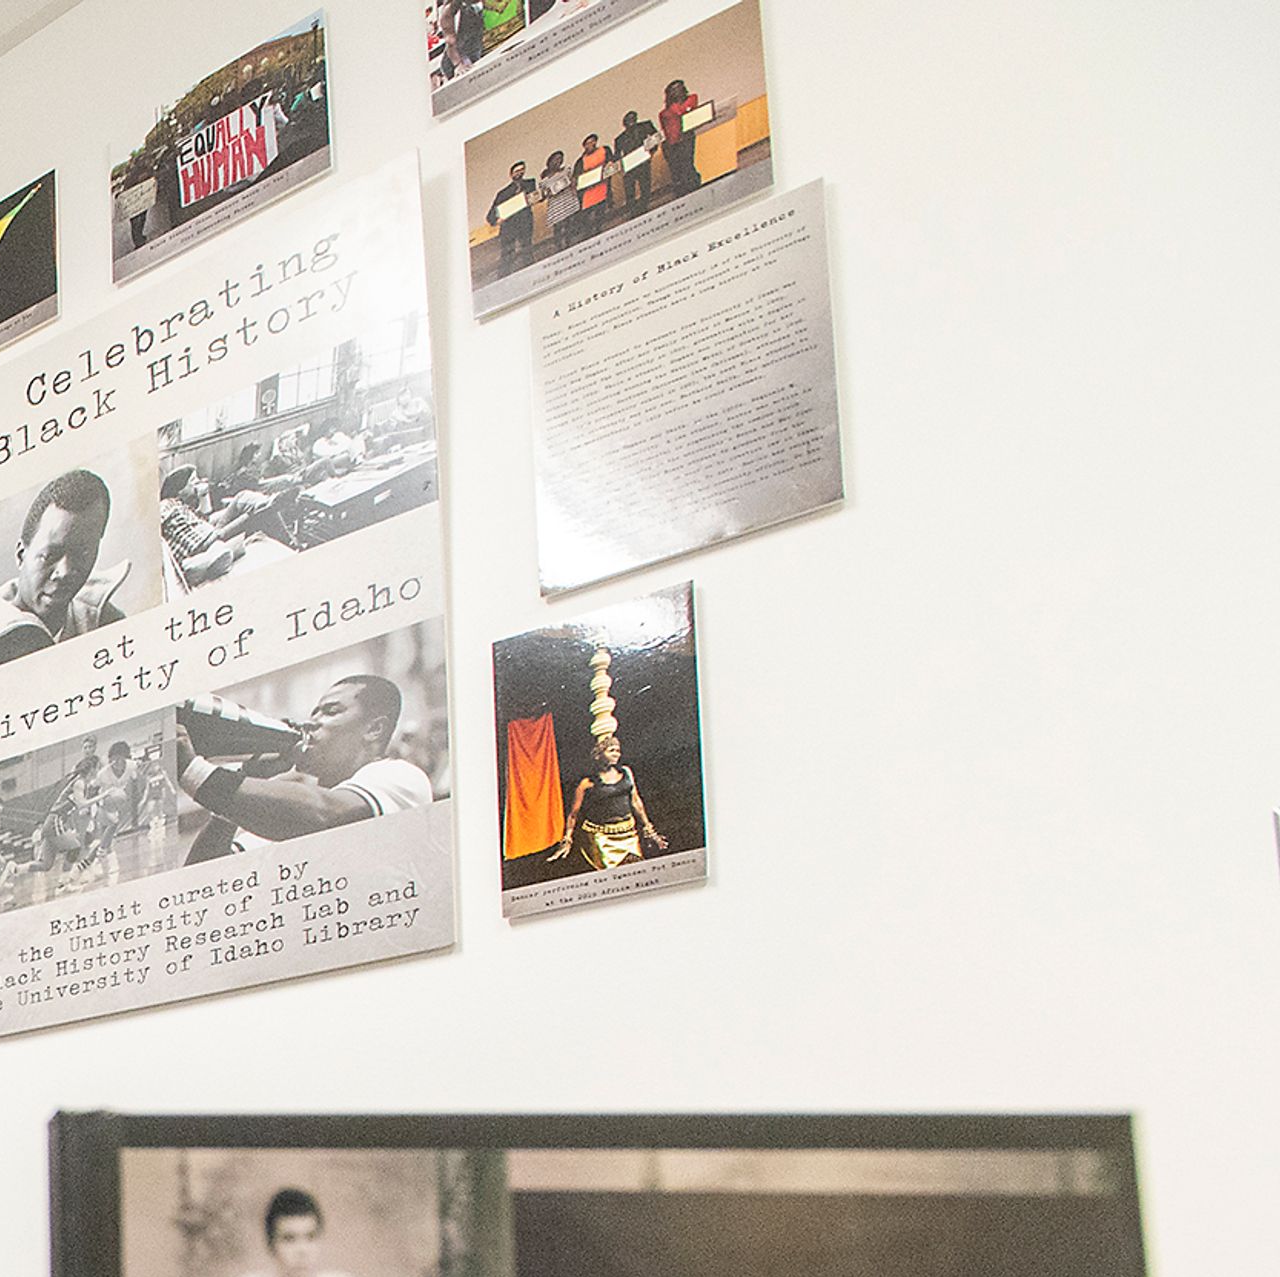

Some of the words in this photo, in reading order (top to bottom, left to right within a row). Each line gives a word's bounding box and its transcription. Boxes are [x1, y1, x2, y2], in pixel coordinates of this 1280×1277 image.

[179, 95, 268, 166] EQUALLY
[180, 126, 268, 206] HUMAN
[552, 307, 560, 319] A
[566, 280, 624, 314] History
[631, 269, 649, 286] of
[655, 247, 699, 275] Black
[707, 207, 796, 253] Excellence
[26, 232, 342, 408] Celebrating
[147, 269, 360, 394] History
[93, 635, 135, 670] at
[164, 603, 235, 644] the
[208, 628, 256, 669] of
[286, 575, 423, 642] Idaho
[18, 941, 55, 964] the
[69, 907, 209, 953] University
[224, 895, 255, 918] of
[271, 873, 350, 907] Idaho
[49, 900, 143, 938] Exhibit
[158, 871, 260, 911] curated
[279, 859, 310, 883] by
[55, 942, 151, 979] History
[164, 911, 286, 955] Research
[302, 896, 351, 922] Lab
[368, 881, 419, 909] and
[16, 963, 151, 1008] University
[165, 952, 193, 976] of
[209, 935, 286, 968] Idaho
[302, 905, 421, 947] Library
